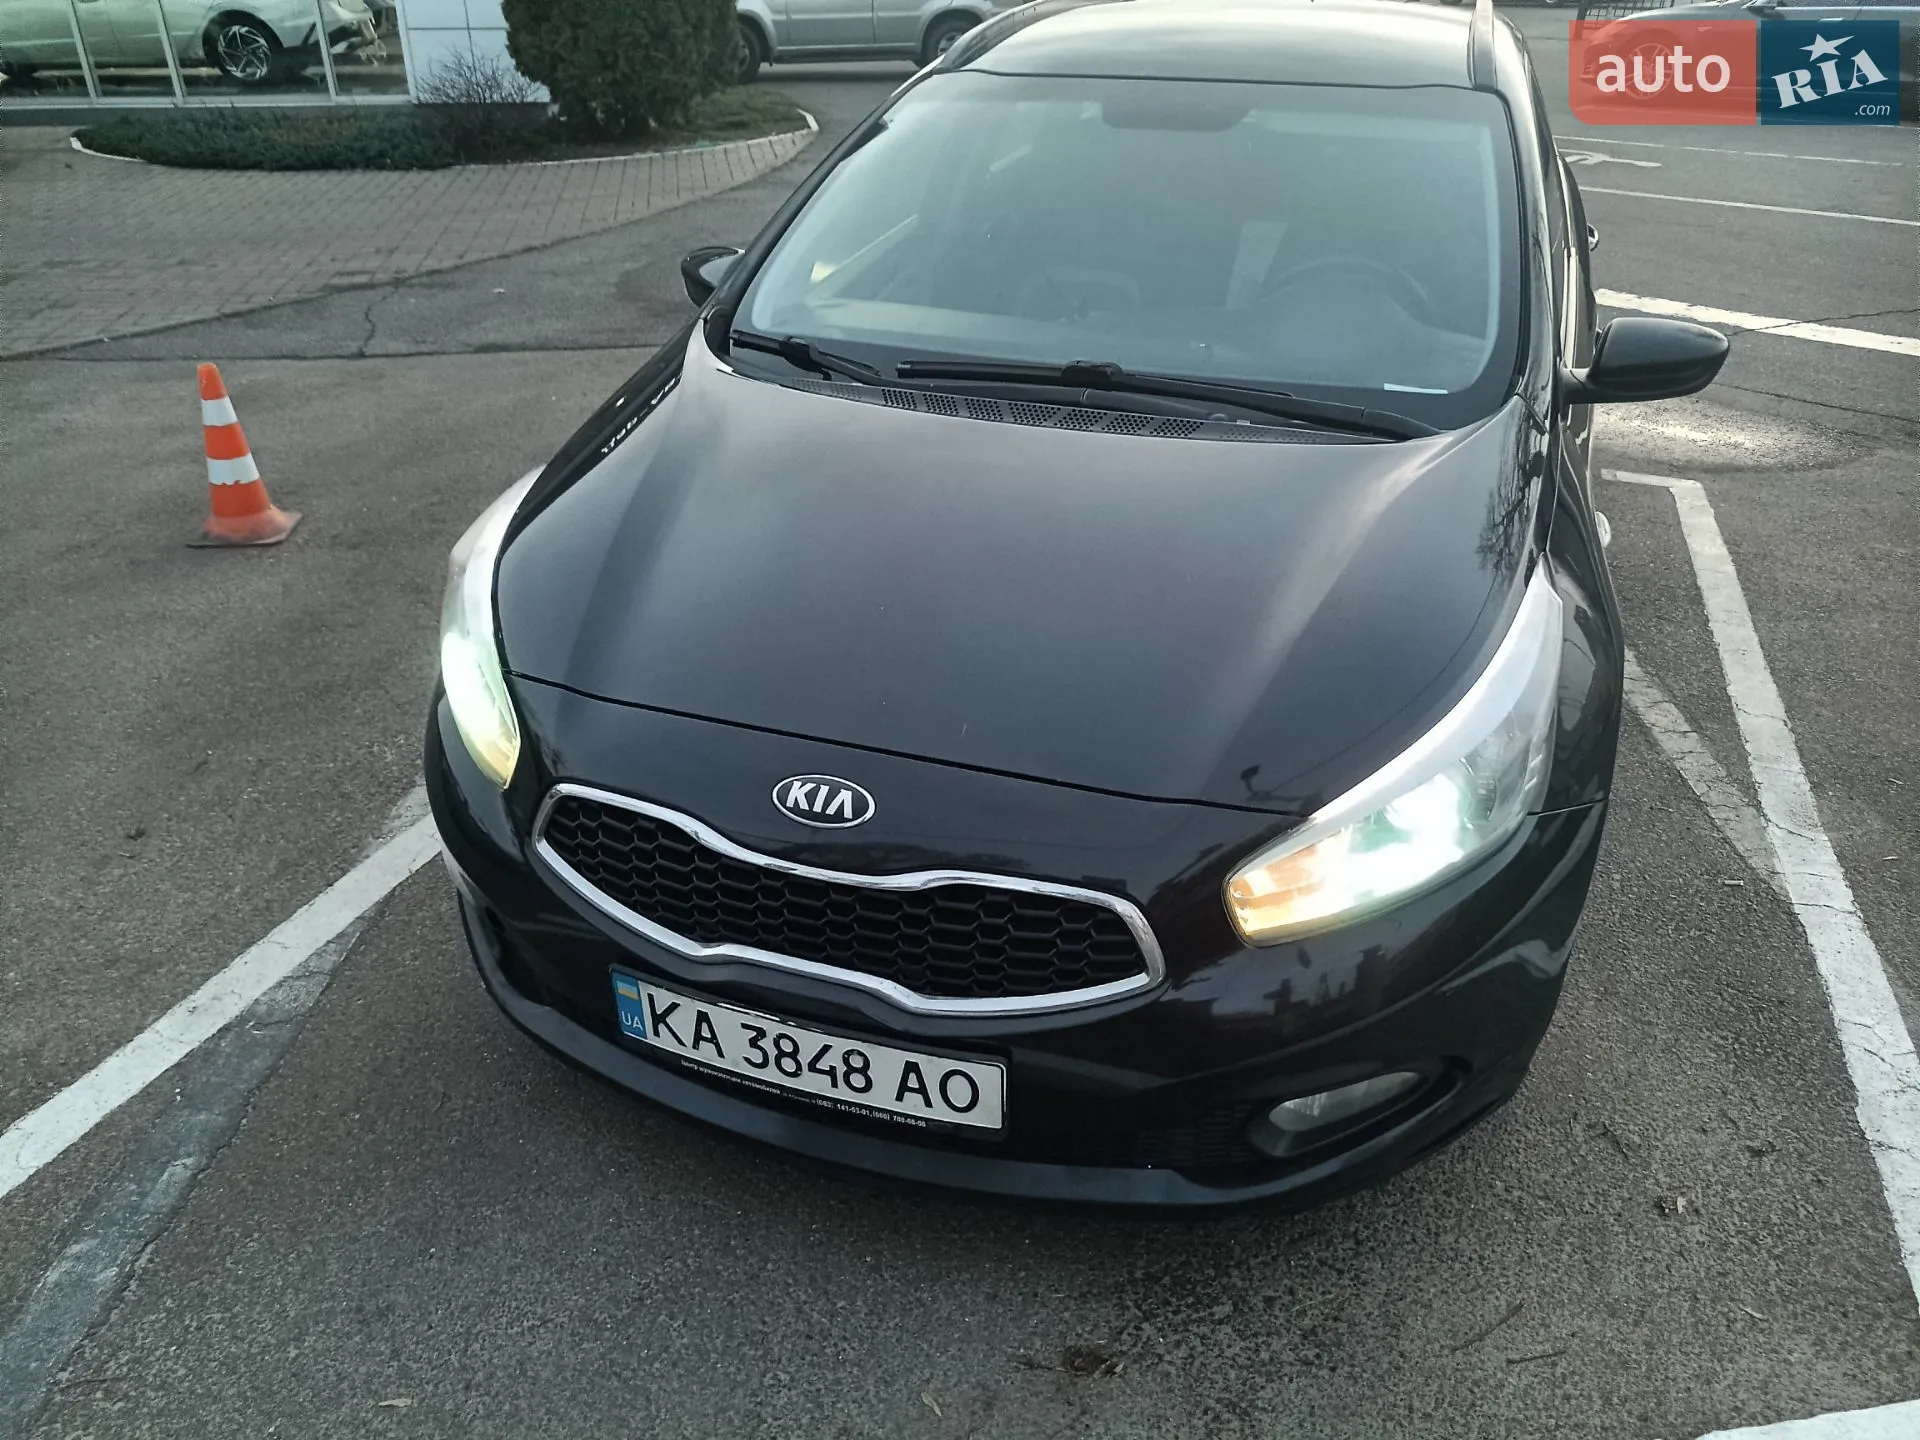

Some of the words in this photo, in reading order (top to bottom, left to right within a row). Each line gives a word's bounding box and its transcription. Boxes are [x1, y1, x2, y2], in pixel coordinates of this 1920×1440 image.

[786, 780, 853, 819] KIA
[621, 1010, 643, 1031] UA
[647, 992, 725, 1059] KA
[741, 1022, 874, 1094] 3848
[895, 1060, 980, 1114] AO
